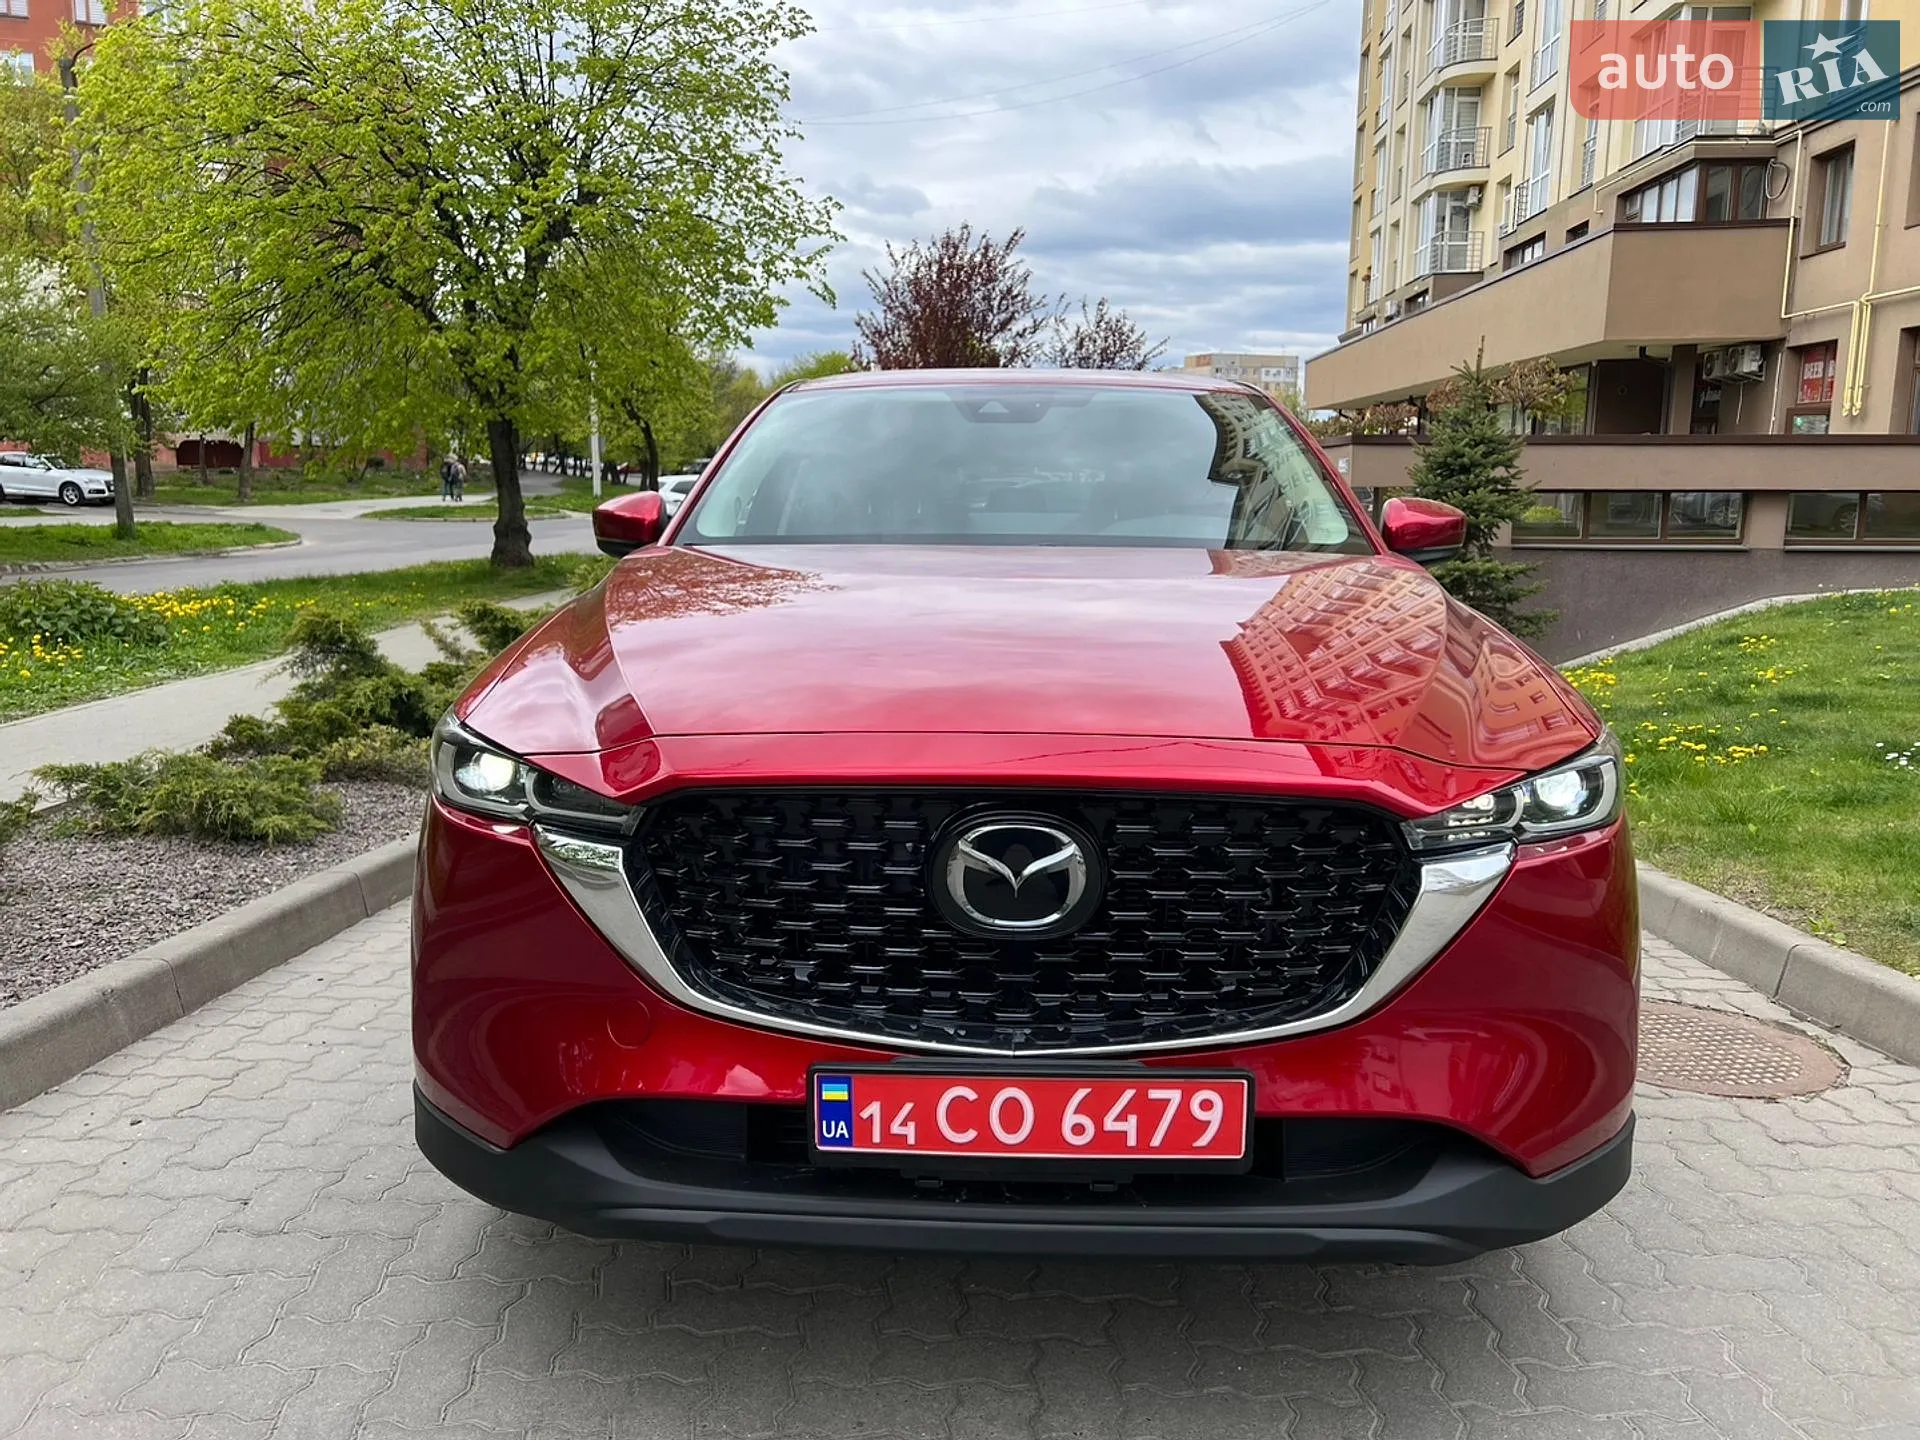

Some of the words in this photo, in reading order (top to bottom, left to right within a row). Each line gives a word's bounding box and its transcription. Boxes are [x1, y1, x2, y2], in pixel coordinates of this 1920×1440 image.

[822, 1119, 850, 1140] UA
[858, 1100, 917, 1146] 14
[935, 1086, 1036, 1146] CO
[1060, 1087, 1225, 1149] 6479
